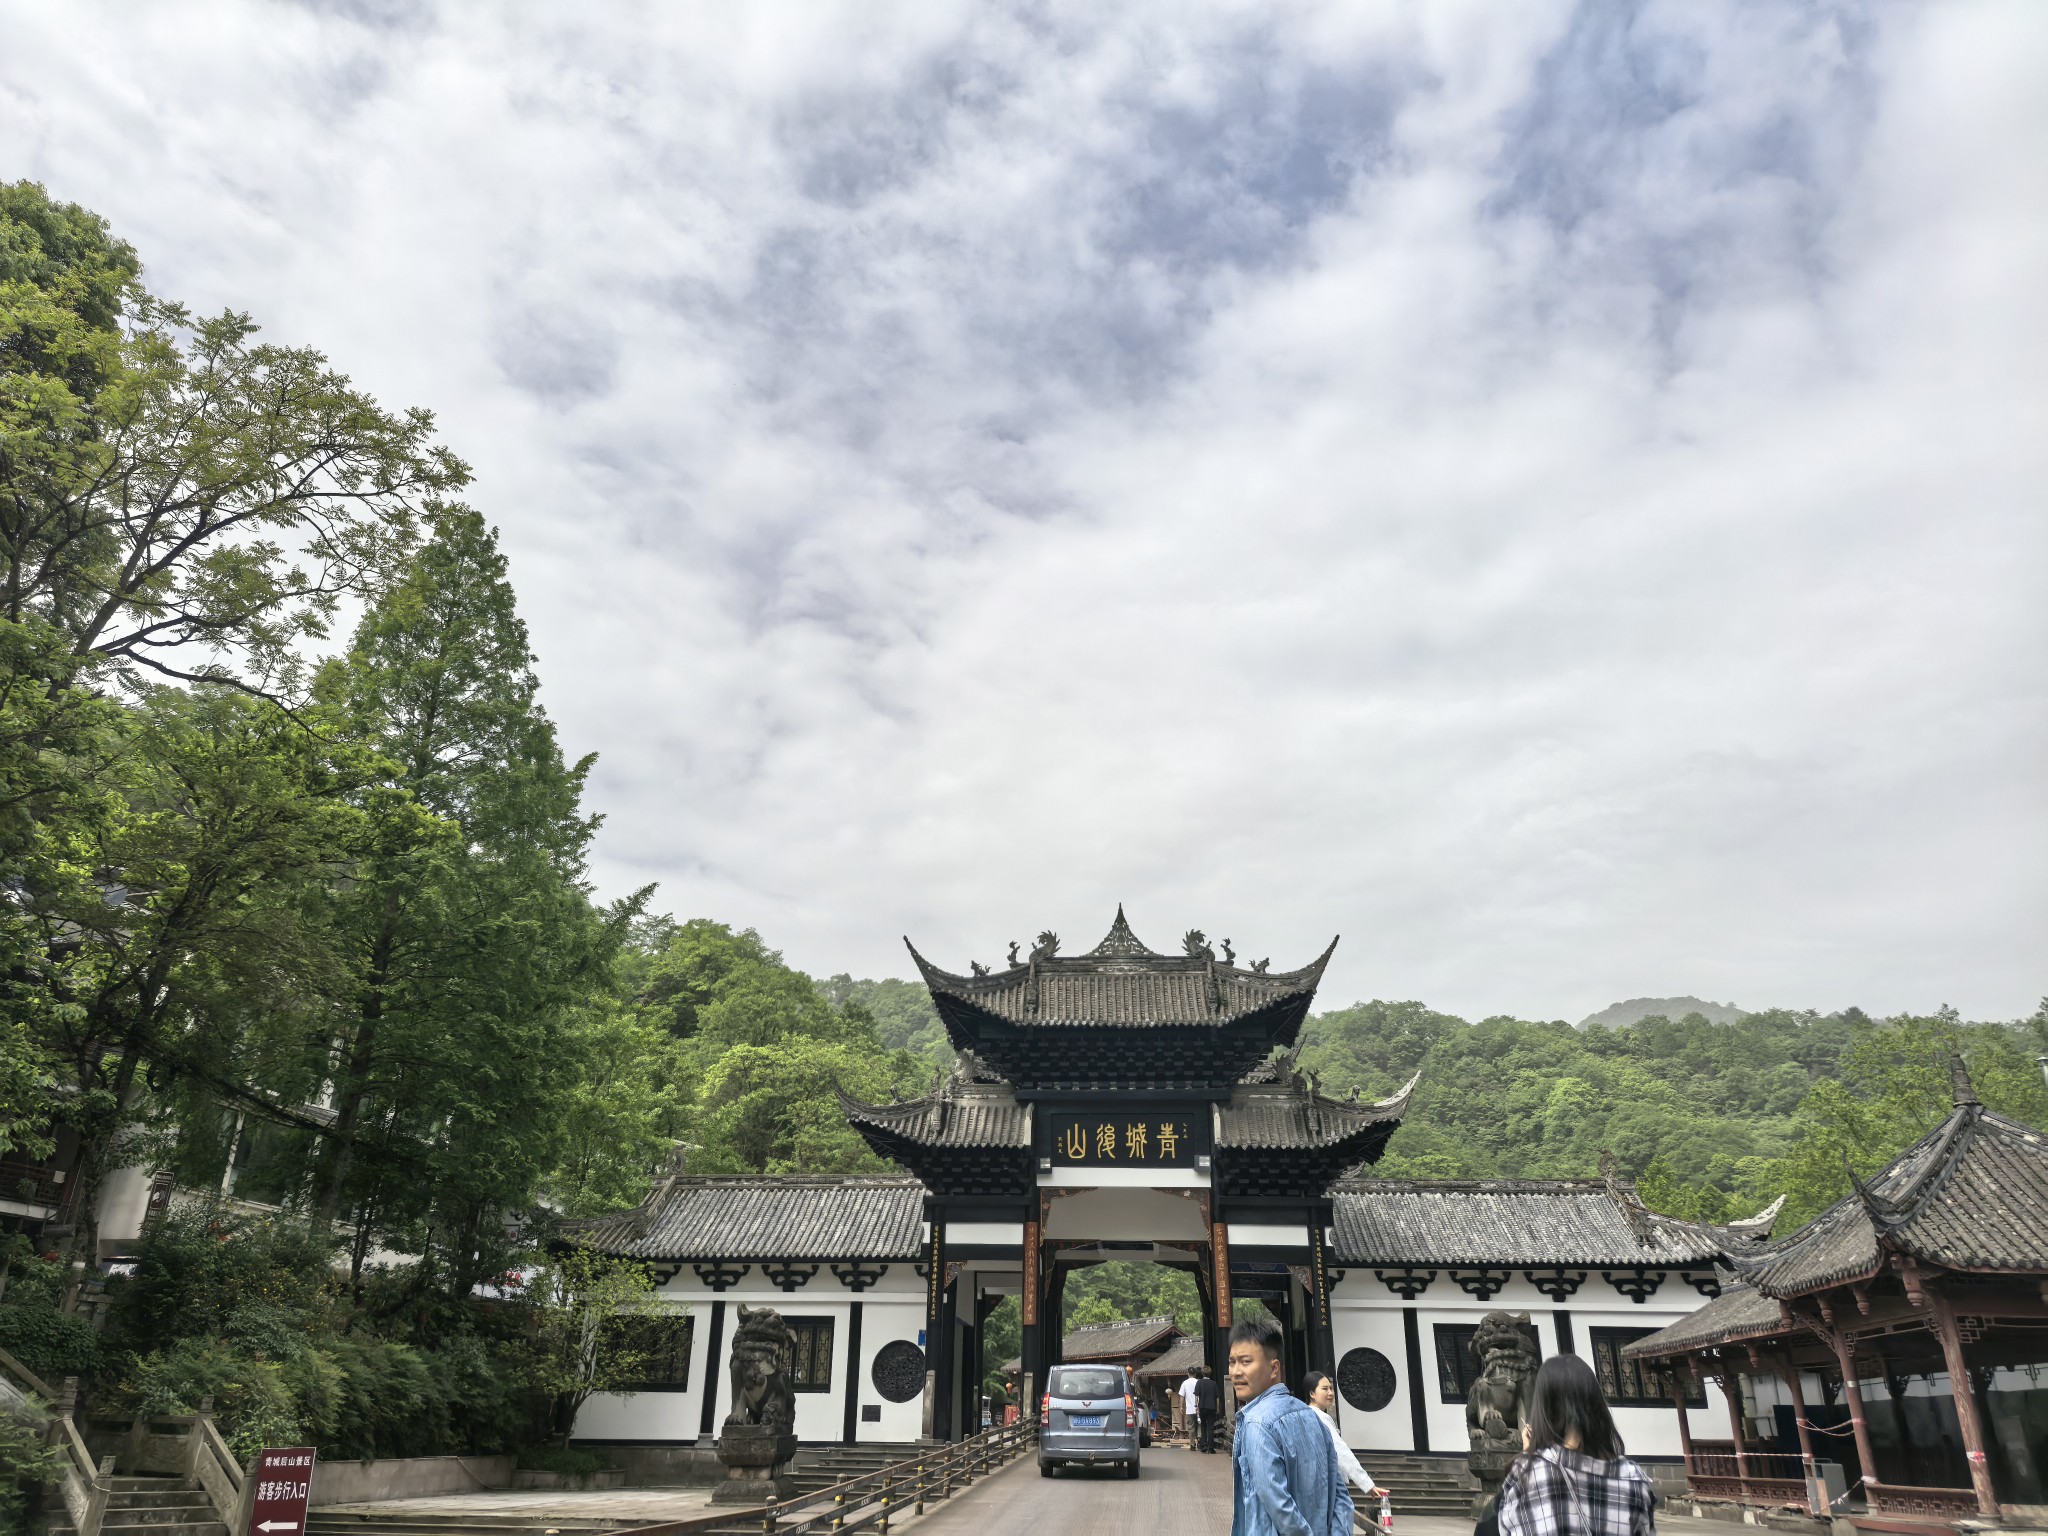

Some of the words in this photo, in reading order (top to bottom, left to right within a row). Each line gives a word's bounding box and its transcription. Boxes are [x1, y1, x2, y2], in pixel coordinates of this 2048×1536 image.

[265, 1456, 311, 1467] 青城后山景区
[257, 1481, 307, 1500] 游客步行入口
